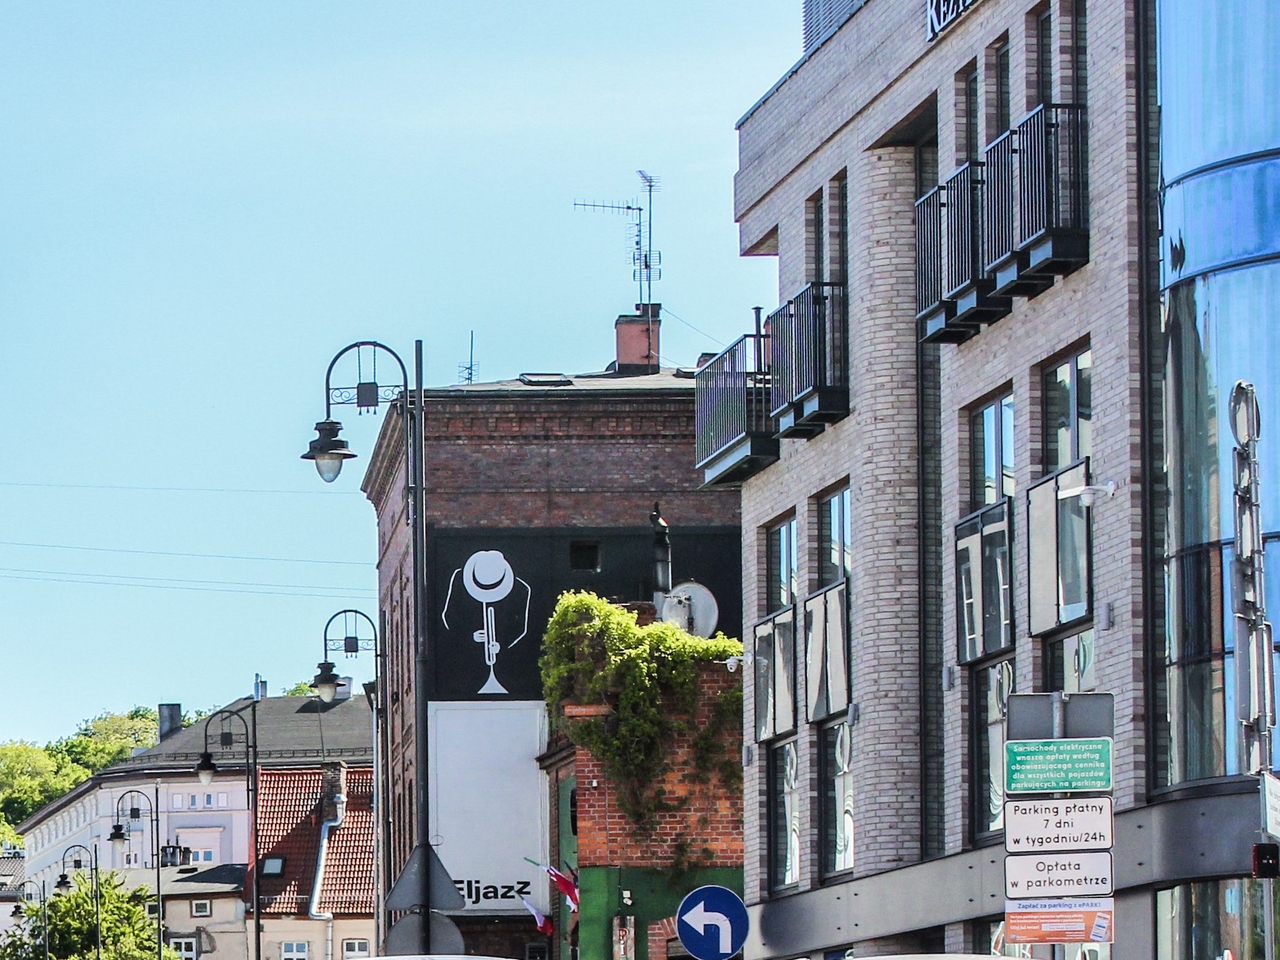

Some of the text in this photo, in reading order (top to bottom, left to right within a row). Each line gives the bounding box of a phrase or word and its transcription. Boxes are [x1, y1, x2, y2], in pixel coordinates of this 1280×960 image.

[1014, 743, 1102, 752] Samochody elektryczne
[1046, 753, 1070, 761] opłaty
[1011, 762, 1072, 771] obowiązującego
[1027, 771, 1065, 779] wszystkich
[1068, 770, 1105, 778] pojazdów
[1011, 781, 1056, 789] parkujących
[1071, 780, 1106, 788] parkingu
[1013, 803, 1104, 817] Parking płatny
[1043, 818, 1074, 829] 7 dni
[1026, 832, 1106, 847] tygodniu/24h
[1036, 862, 1081, 874] Opłata
[1010, 876, 1108, 891] w parkometrze
[452, 879, 531, 905] Eljazz
